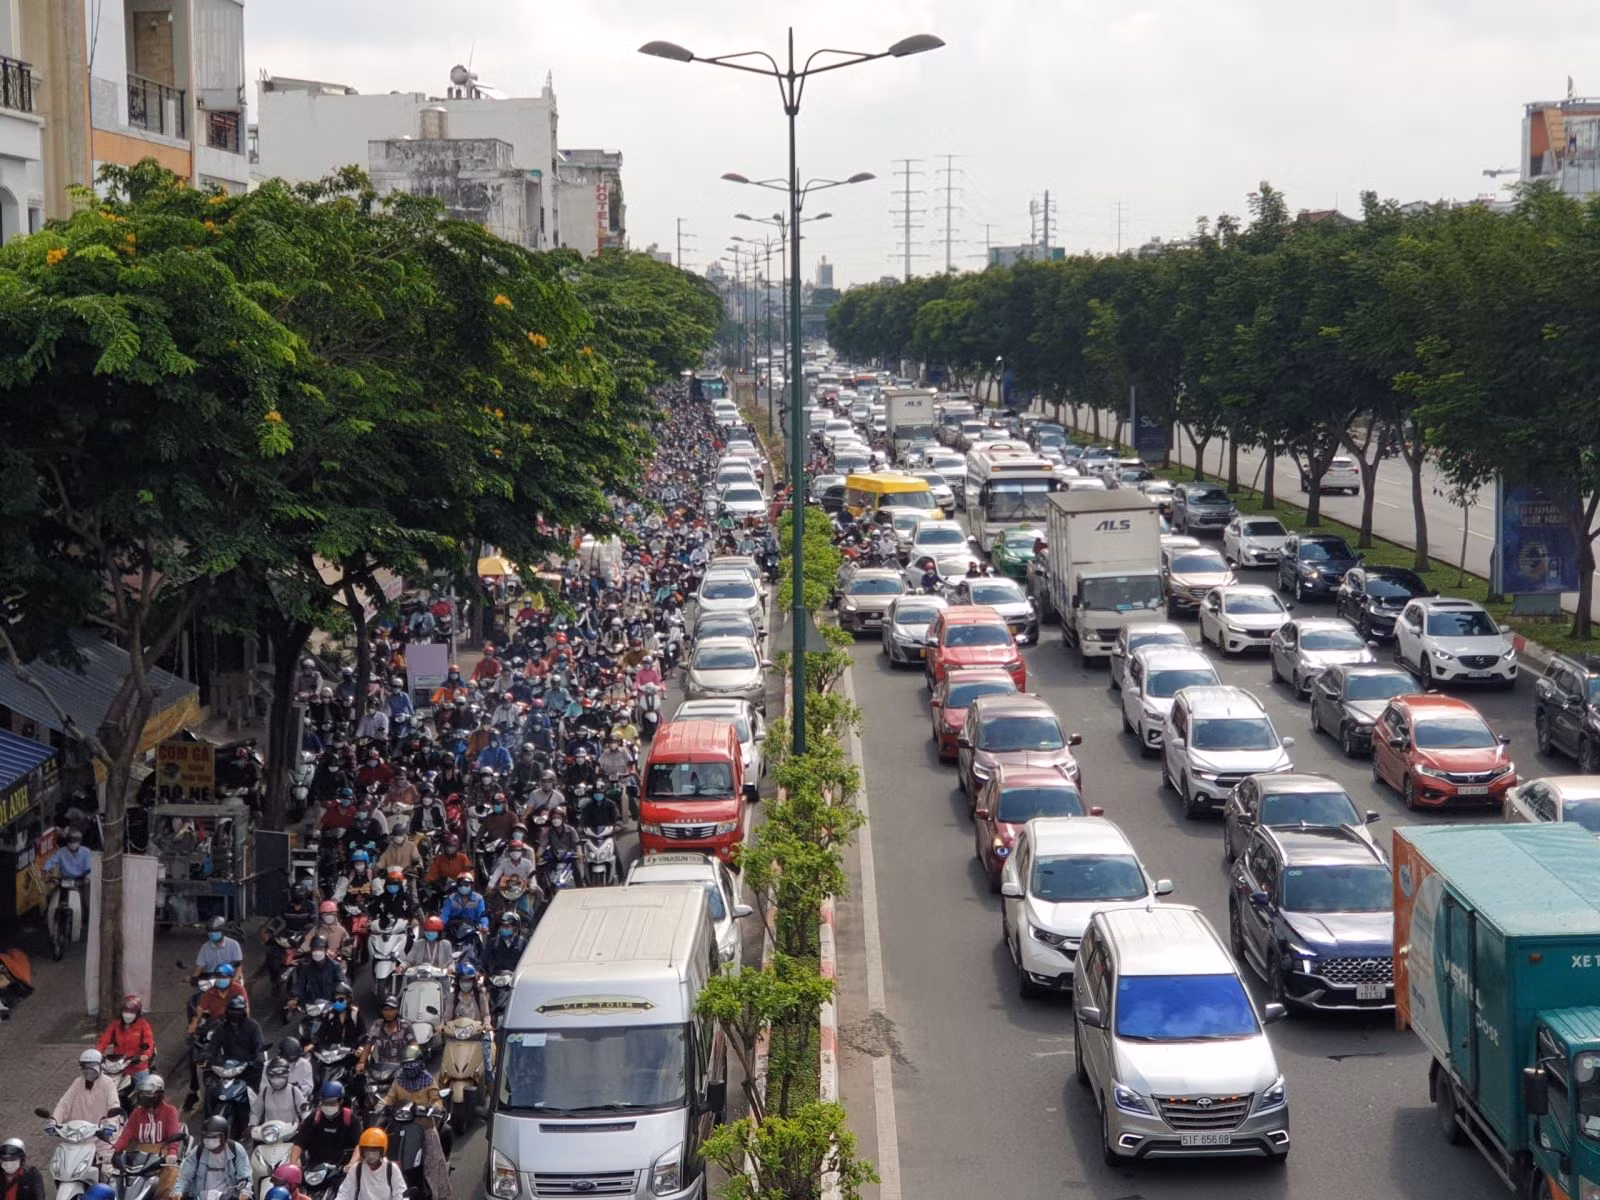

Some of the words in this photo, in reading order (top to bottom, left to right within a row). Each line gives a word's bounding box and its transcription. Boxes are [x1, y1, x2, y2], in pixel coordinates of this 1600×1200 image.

[596, 184, 608, 229] HOTEL
[1094, 520, 1131, 531] ALS
[1571, 955, 1592, 968] XE
[1182, 1135, 1198, 1145] 51F
